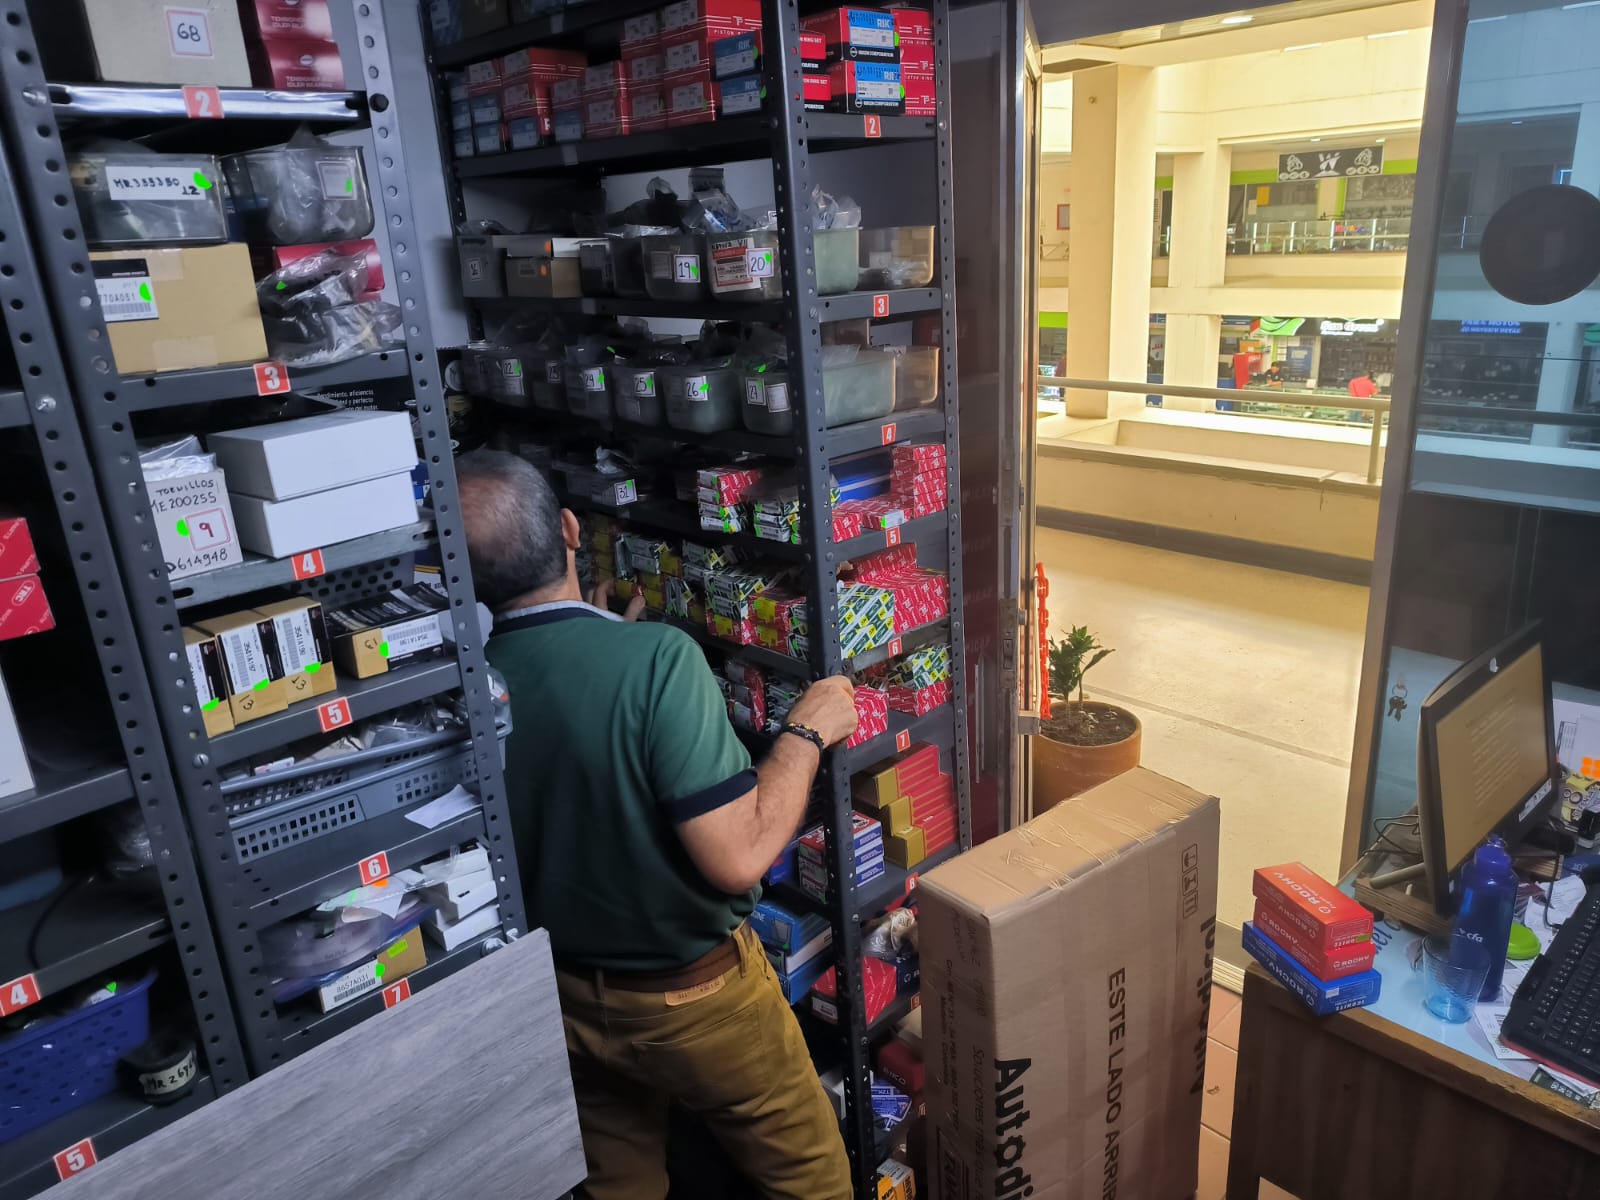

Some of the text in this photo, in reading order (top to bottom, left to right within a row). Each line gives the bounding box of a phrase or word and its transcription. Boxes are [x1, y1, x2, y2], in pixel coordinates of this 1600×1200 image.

[877, 19, 891, 28] RIK
[176, 23, 202, 43] 68
[193, 91, 214, 117] 2
[869, 117, 876, 134] 2
[182, 185, 201, 196] 12
[678, 262, 691, 279] 19
[750, 256, 766, 272] 20
[878, 298, 885, 314] 3
[264, 364, 281, 389] 3
[634, 378, 647, 393] 25
[686, 382, 699, 398] 26
[884, 426, 893, 442] 4
[618, 486, 630, 499] 31
[199, 522, 215, 538] 9
[890, 531, 897, 544] 5
[301, 553, 316, 572] 4
[892, 641, 899, 655] 6
[291, 676, 307, 691] 13
[239, 694, 255, 711] 13
[328, 703, 343, 725] 5
[900, 733, 908, 748] 7
[367, 859, 382, 876] 6
[909, 877, 916, 889] 8
[1466, 932, 1483, 943] cfa
[7, 984, 27, 1005] 4
[391, 985, 401, 1003] 7
[1108, 967, 1126, 1046] ESTE
[1106, 1047, 1124, 1124] LADO
[66, 1150, 86, 1171] 5
